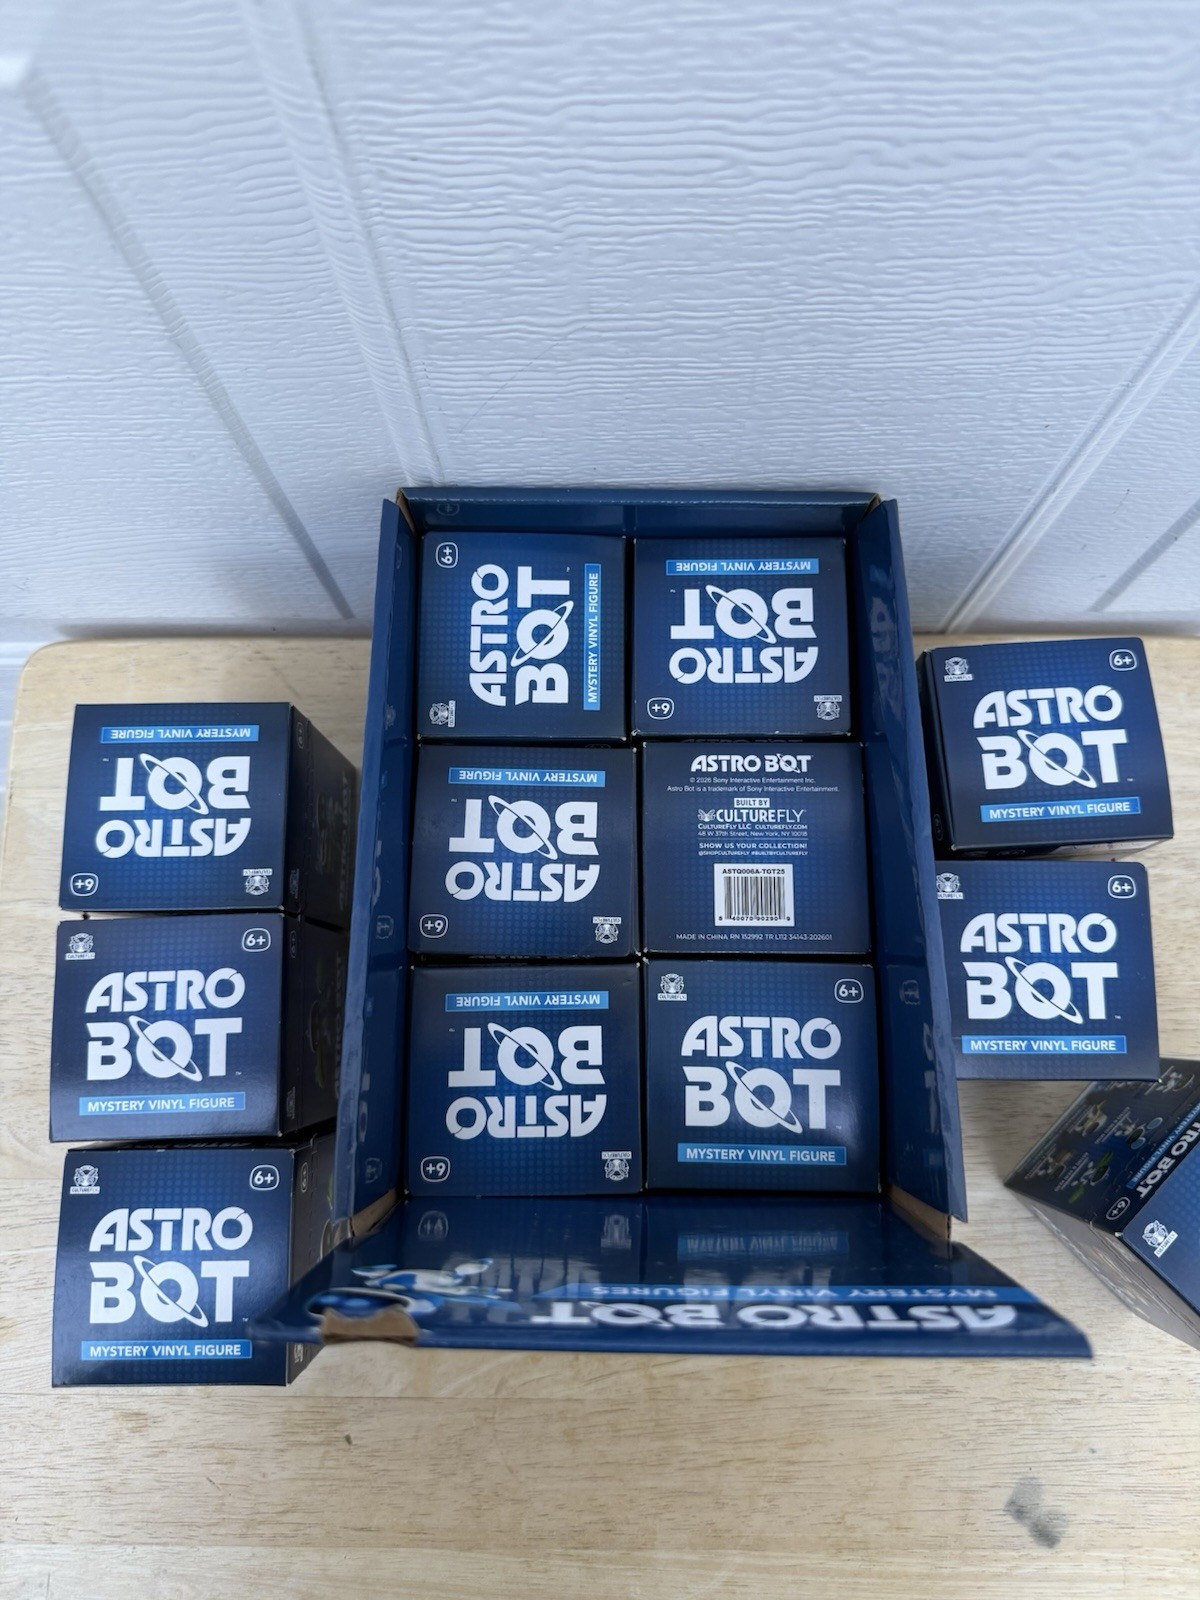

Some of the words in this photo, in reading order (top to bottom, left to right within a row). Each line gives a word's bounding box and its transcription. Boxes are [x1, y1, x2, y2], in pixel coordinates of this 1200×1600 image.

[441, 546, 453, 564] 6+
[676, 562, 718, 572] FIGURE
[721, 562, 755, 572] VINYL
[758, 561, 811, 571] MYSTERY
[588, 572, 599, 613] FIGURE
[670, 584, 817, 644] BOT
[469, 564, 510, 706] ASTRO
[510, 565, 574, 706] BOT
[588, 616, 599, 648] VINYL
[668, 646, 819, 685] ASTRO
[1113, 654, 1132, 666] 6+
[588, 652, 599, 703] MYSTERY
[651, 702, 670, 714] 6+
[973, 684, 1123, 728] ASTRO
[110, 729, 154, 739] FIGURE
[158, 728, 193, 738] VINYL
[196, 728, 250, 738] MYSTERY
[690, 754, 762, 772] ASTRO
[764, 754, 812, 774] BOT
[976, 729, 1128, 790] BOT
[458, 770, 502, 780] FIGURE
[506, 772, 540, 782] VINYL
[544, 772, 598, 782] MYSTERY
[98, 753, 251, 815] BOT
[716, 809, 805, 822] CULTUREFLY
[989, 807, 1044, 819] MYSTERY
[1048, 804, 1084, 816] VINYL
[1087, 802, 1130, 814] FIGURE
[448, 794, 600, 860] BOT
[96, 818, 252, 858] ASTRO
[74, 877, 94, 890] 6+
[445, 861, 600, 902] ASTRO
[1112, 881, 1132, 892] 6+
[424, 920, 442, 932] 6+
[960, 912, 1117, 954] ASTRO
[246, 934, 266, 946] 6+
[85, 967, 246, 1014] ASTRO
[838, 984, 858, 997] 6+
[962, 956, 1118, 1024] BOT
[456, 996, 500, 1007] FIGURE
[504, 995, 541, 1006] VINYL
[544, 994, 600, 1005] MYSTERY
[681, 1016, 842, 1060] ASTRO
[970, 1040, 1028, 1050] MYSTERY
[1030, 1040, 1068, 1050] VINYL
[1071, 1040, 1116, 1050] FIGURE
[86, 1016, 243, 1082] BOT
[448, 1022, 606, 1091] BOT
[87, 1100, 145, 1112] MYSTERY
[148, 1099, 185, 1110] VINYL
[189, 1097, 235, 1108] FIGURE
[682, 1061, 841, 1134] BOT
[446, 1094, 607, 1140] ASTRO
[686, 1148, 744, 1160] MYSTERY
[748, 1149, 786, 1161] VINYL
[790, 1150, 836, 1162] FIGURE
[426, 1162, 446, 1176] 6+
[1136, 1156, 1176, 1198] BOT
[254, 1172, 274, 1184] 6+
[1112, 1200, 1126, 1216] 6+
[89, 1206, 253, 1252] ASTRO
[89, 1255, 250, 1327] BOT
[592, 1286, 729, 1296] FIGURES
[739, 1288, 838, 1297] VINYL
[848, 1288, 998, 1297] MYSTERY
[530, 1301, 726, 1328] BOT
[737, 1304, 1018, 1330] ASTRO
[90, 1346, 149, 1357] MYSTERY
[152, 1345, 191, 1356] VINYL
[194, 1344, 241, 1356] FIGURE
